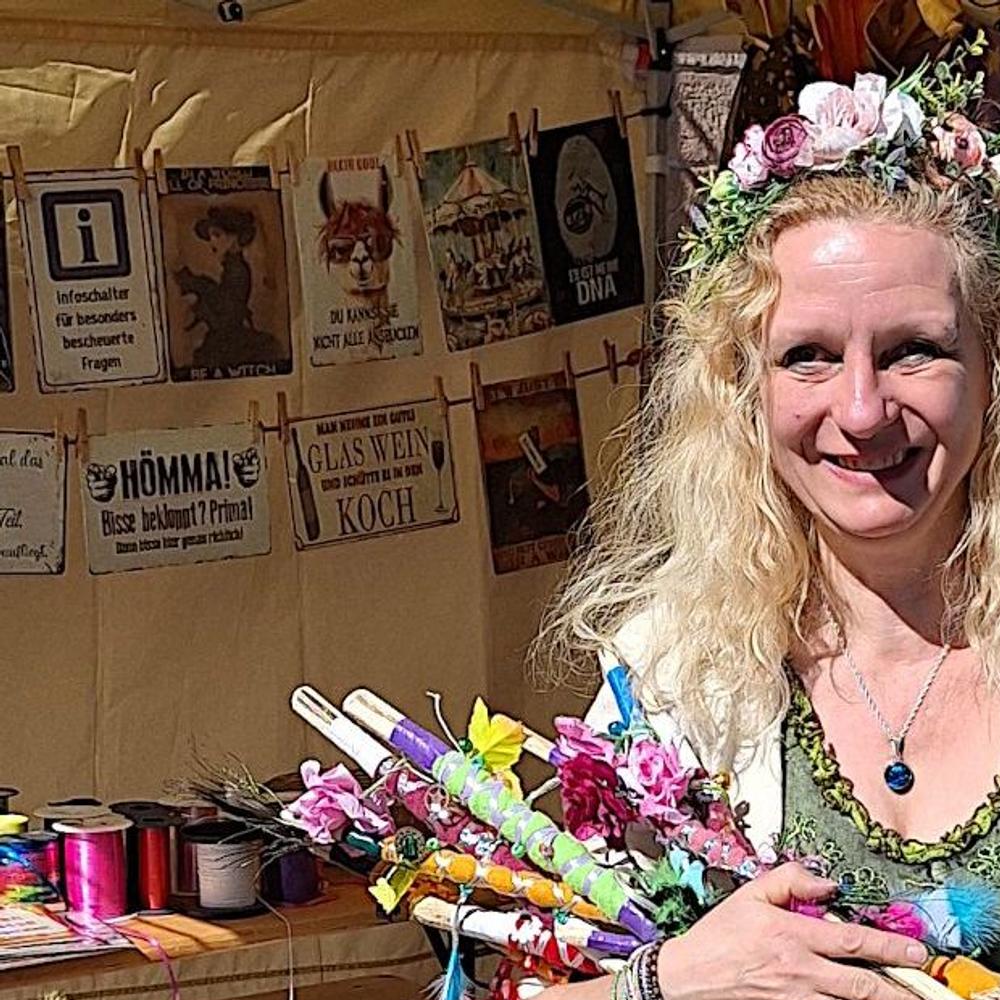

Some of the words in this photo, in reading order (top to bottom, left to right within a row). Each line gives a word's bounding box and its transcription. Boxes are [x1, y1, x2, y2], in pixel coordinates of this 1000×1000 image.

[56, 287, 130, 304] Infoschalter
[576, 273, 618, 306] DNA
[56, 312, 74, 328] für
[76, 310, 137, 326] besonders
[62, 331, 134, 349] bescheuerte
[81, 356, 122, 372] Fragen
[307, 437, 365, 474] GLAS
[369, 426, 431, 464] WEIN
[119, 450, 231, 500] HÖMMA!
[101, 509, 136, 537] Bisse
[336, 487, 417, 536] KOCH
